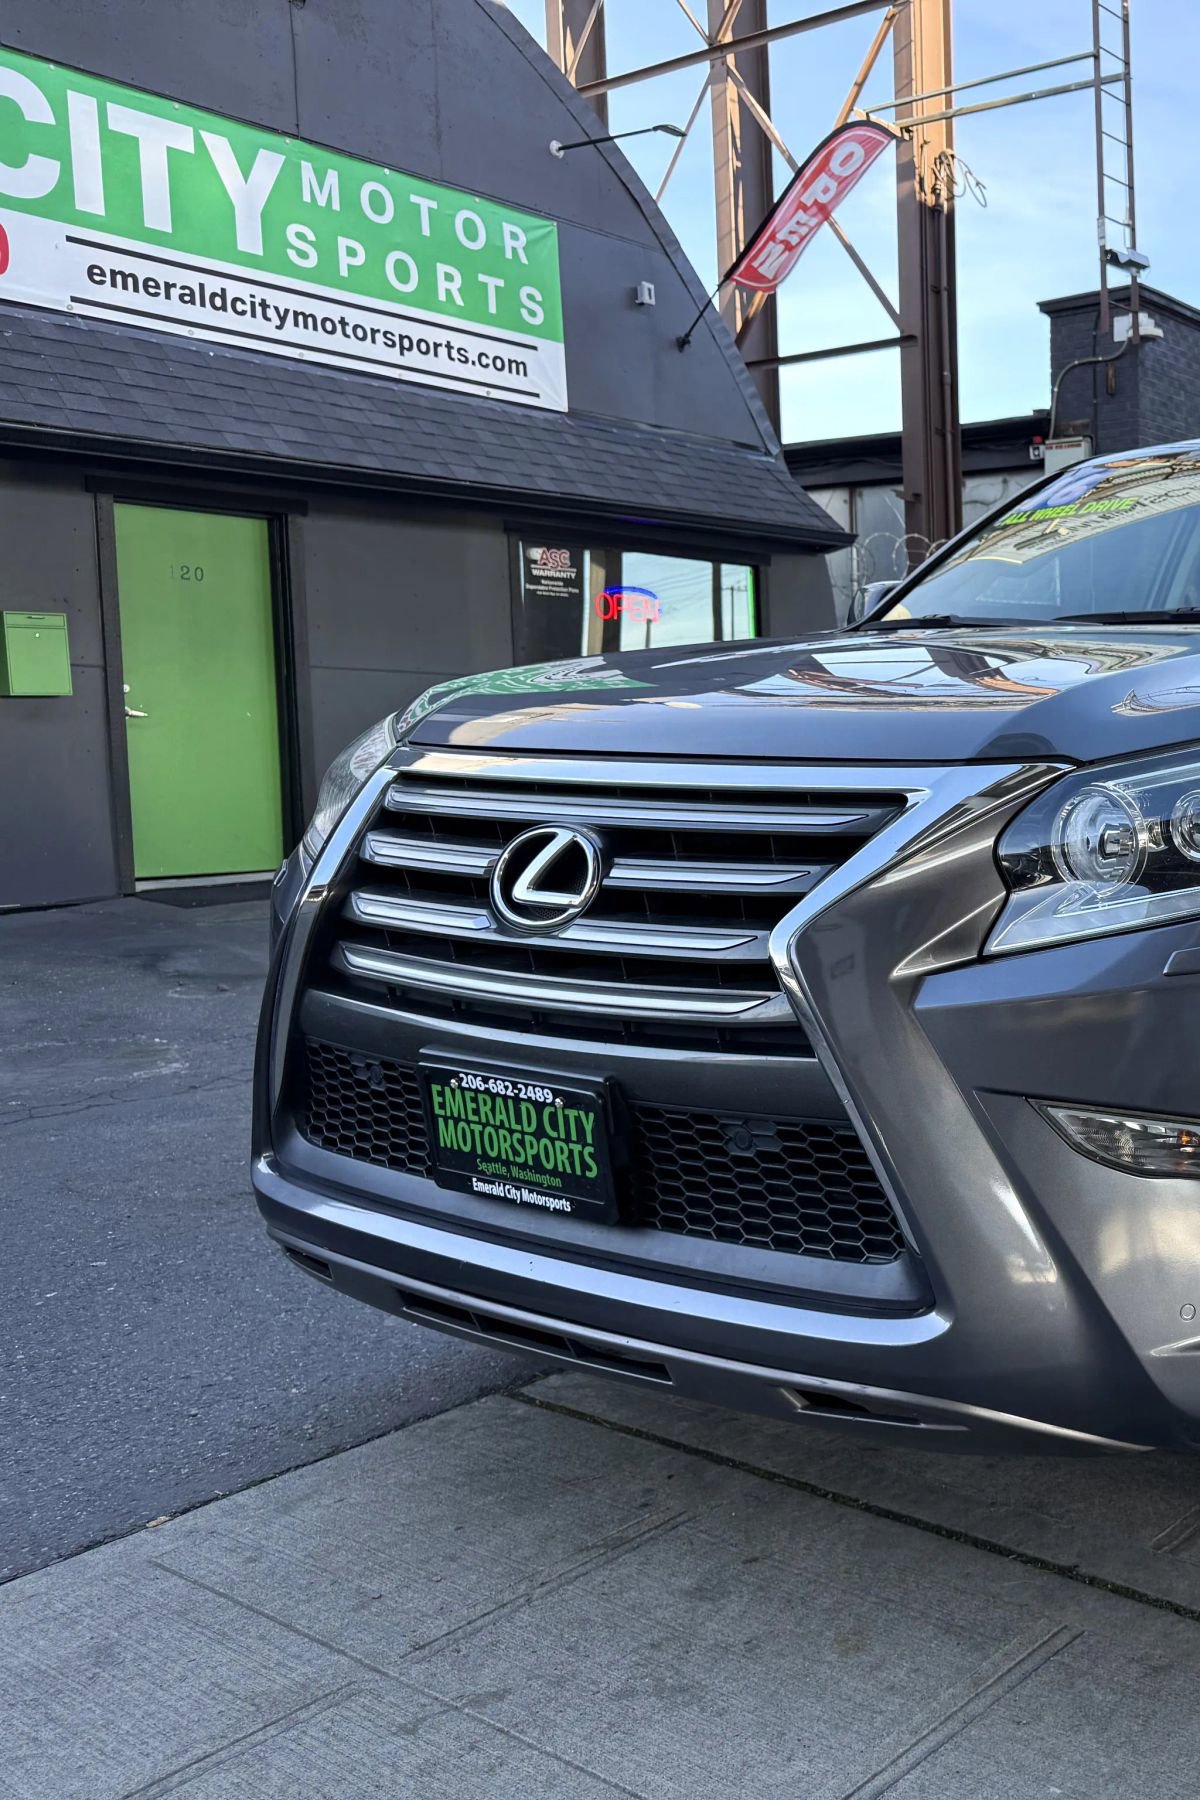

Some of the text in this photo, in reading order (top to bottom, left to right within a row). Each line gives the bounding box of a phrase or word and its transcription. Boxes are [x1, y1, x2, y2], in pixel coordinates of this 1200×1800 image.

[0, 66, 286, 256] CITY
[301, 160, 529, 265] MOTOR
[751, 141, 865, 280] OPEN
[286, 223, 545, 326] SPORTS
[87, 263, 529, 378] emeraldcitymotorsports.com
[1001, 497, 1140, 526] ALL WHEEL DRIVE
[531, 569, 576, 579] WARRANTY
[538, 547, 571, 570] ASC
[595, 592, 660, 624] OPEN
[458, 1073, 554, 1104] 206-682-2489
[431, 1084, 595, 1144] EMERALD CITY
[438, 1118, 598, 1179] MOTORSPORTS
[472, 1177, 572, 1212] Emerald City Motorsports
[477, 1158, 562, 1188] Seattle, Washington
